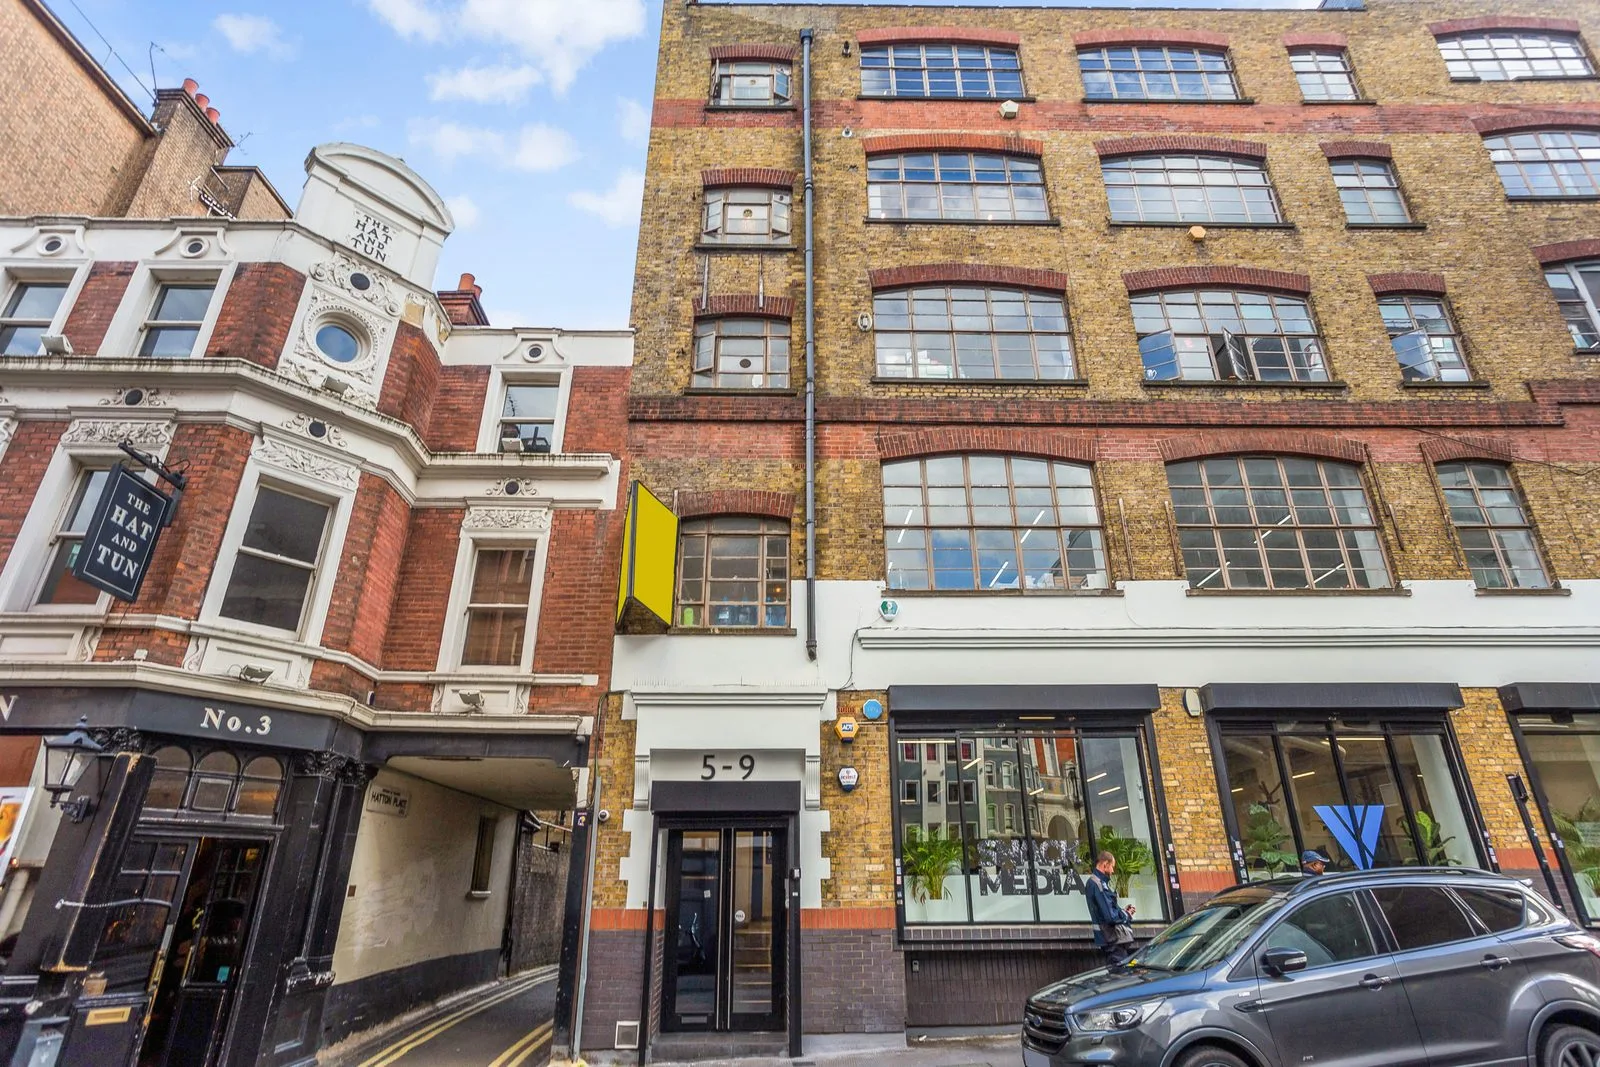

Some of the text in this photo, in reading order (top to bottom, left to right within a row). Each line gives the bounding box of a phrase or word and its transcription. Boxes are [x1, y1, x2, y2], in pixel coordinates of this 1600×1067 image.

[355, 219, 393, 245] HAT
[364, 214, 390, 234] THE
[350, 237, 387, 263] TUN
[356, 232, 385, 250] AND
[127, 492, 151, 516] THE
[110, 504, 153, 541] HAT
[111, 532, 138, 553] AND
[96, 543, 139, 580] TUN
[700, 754, 755, 780] 5-9
[370, 791, 393, 806] HATTON
[978, 867, 1088, 897] MEDIA
